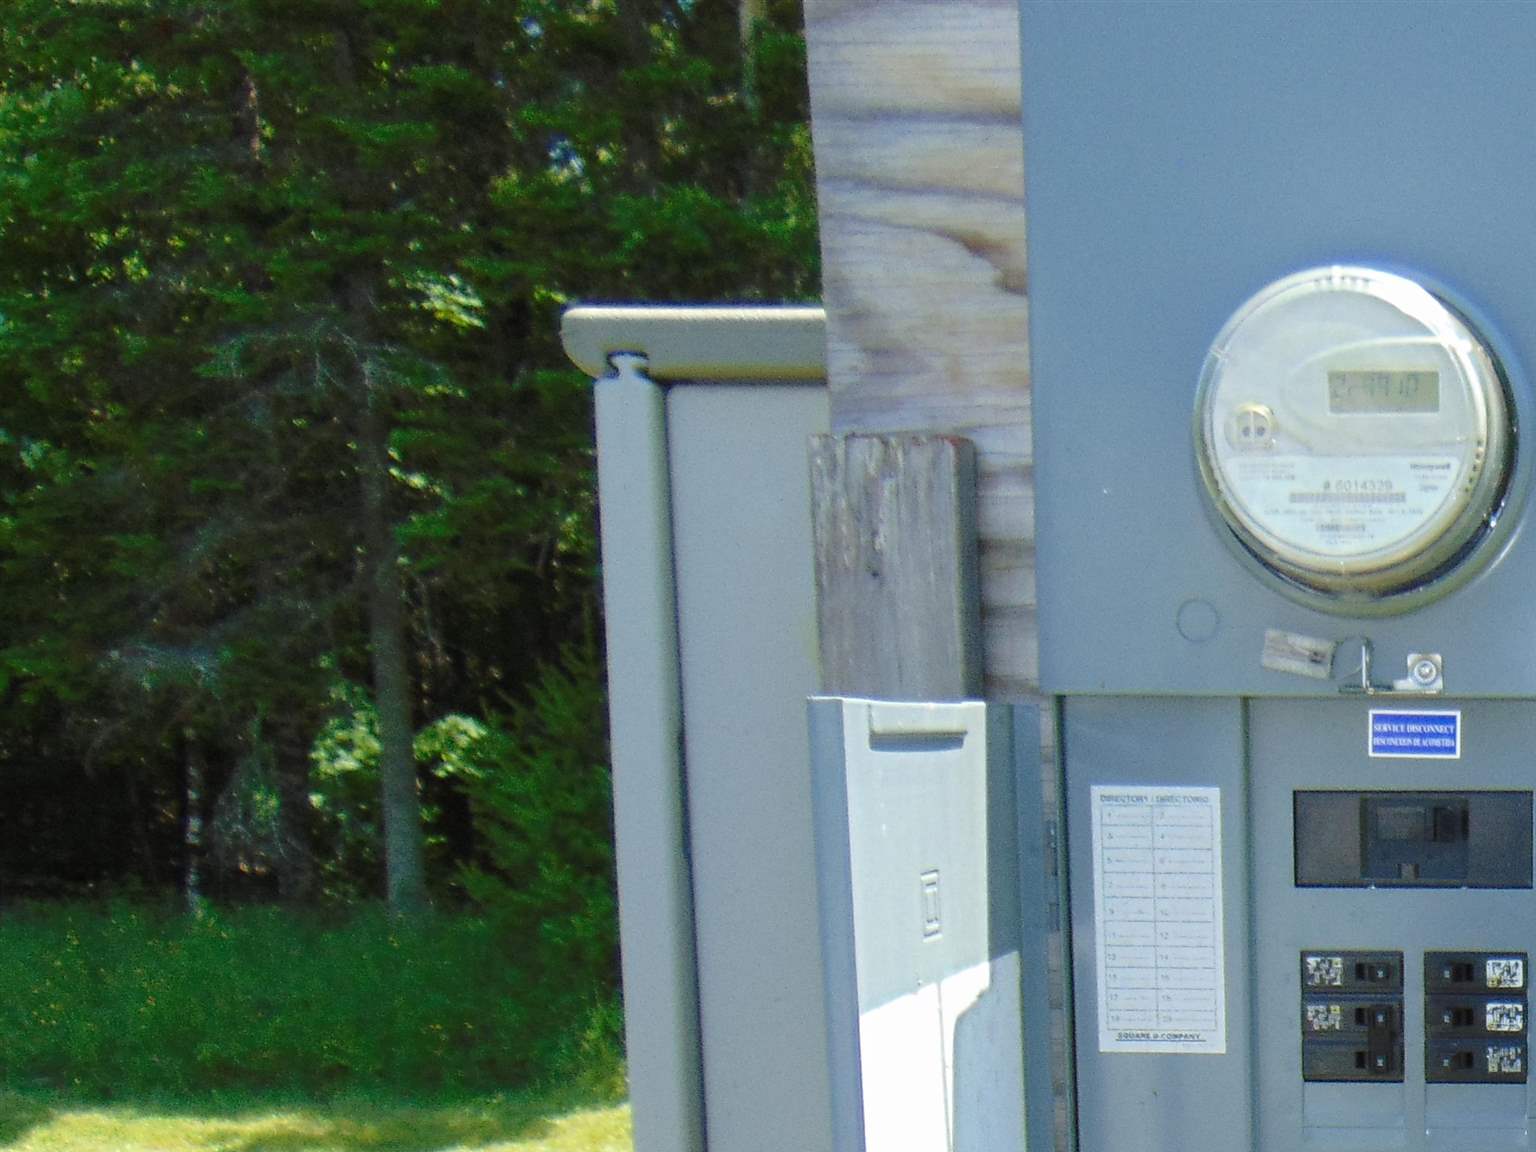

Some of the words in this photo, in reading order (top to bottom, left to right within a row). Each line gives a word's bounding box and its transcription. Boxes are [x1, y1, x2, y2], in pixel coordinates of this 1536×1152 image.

[1373, 724, 1405, 733] SERVICE
[1407, 724, 1454, 734] DISCONNECT
[1160, 1032, 1201, 1040] COMPANY
